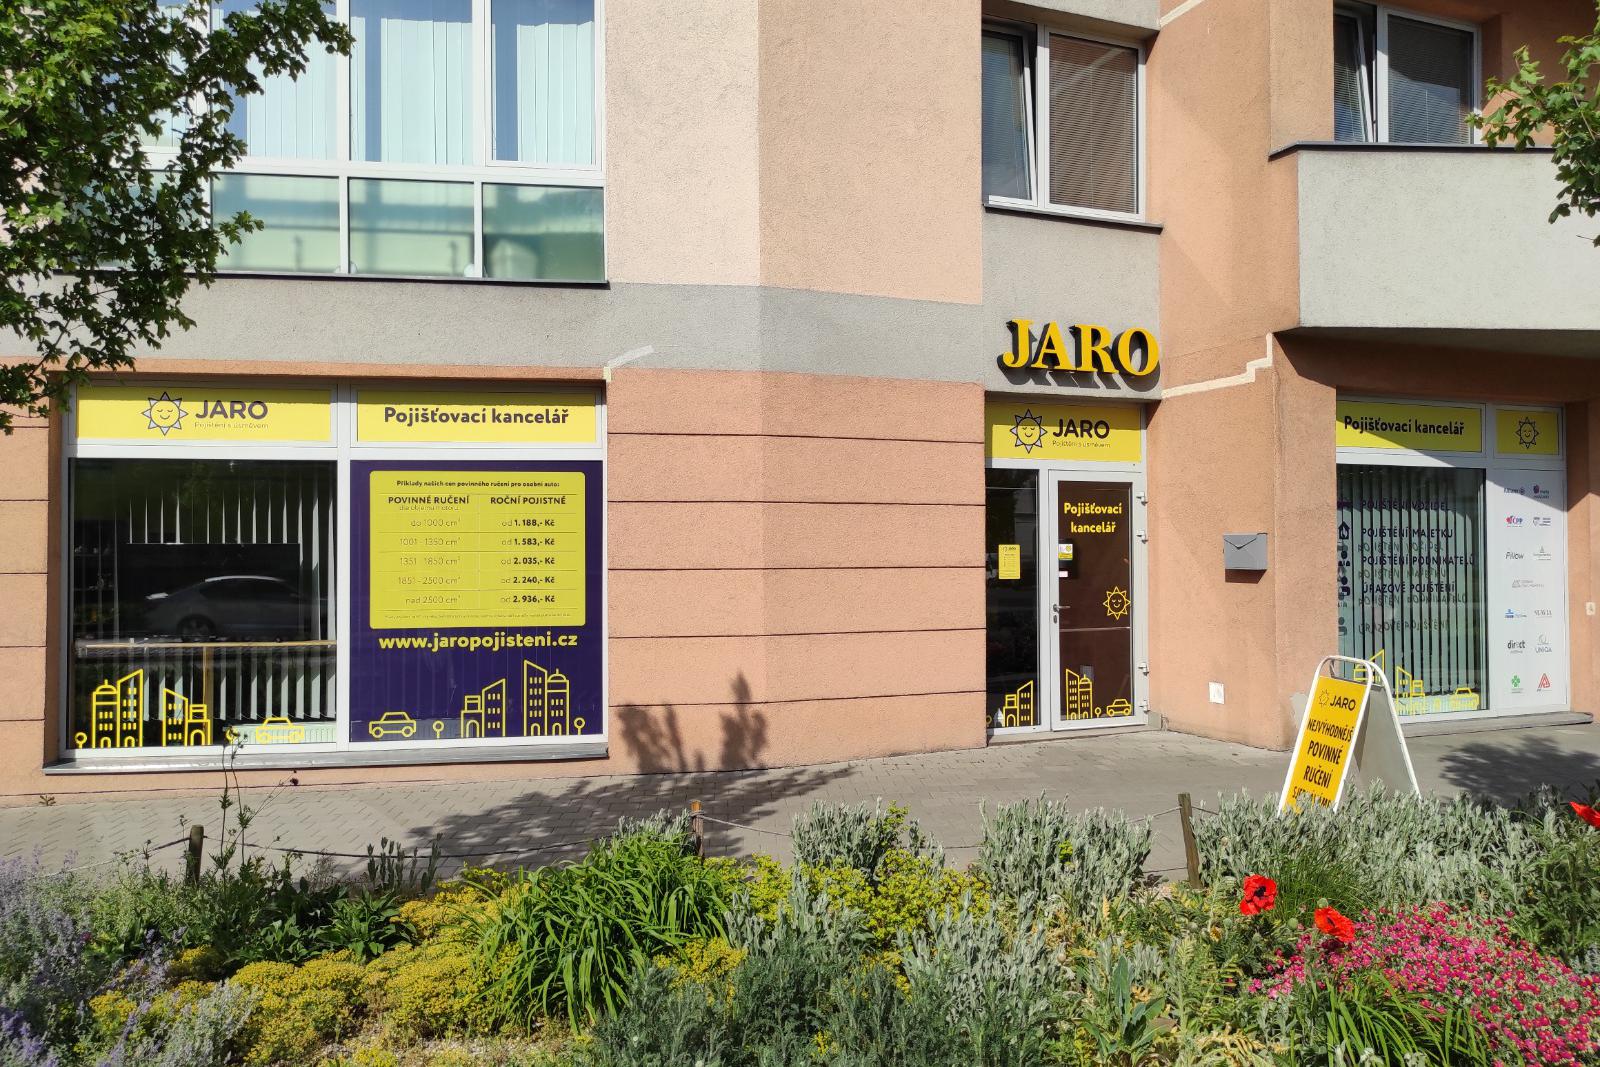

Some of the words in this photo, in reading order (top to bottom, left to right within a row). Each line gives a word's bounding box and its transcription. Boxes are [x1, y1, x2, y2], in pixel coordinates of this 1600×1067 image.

[1001, 318, 1160, 377] JARO
[195, 400, 268, 420] JARO
[384, 406, 486, 427] Pojišťovací
[491, 408, 569, 424] kancelář
[1052, 418, 1111, 440] JARO
[1344, 415, 1412, 434] Pojišťovací
[1415, 419, 1465, 436] kancelář
[457, 480, 490, 488] povinného
[388, 495, 432, 504] POVINNÉ
[434, 495, 470, 504] RUČENÍ
[490, 495, 520, 504] ROČNÍ
[523, 496, 567, 504] POJISTNÉ
[1064, 502, 1123, 517] Pojišťovací
[545, 519, 555, 527] Kč
[1070, 522, 1116, 533] kancelář
[1361, 526, 1409, 538] POJIŠTĚNÍ
[1412, 528, 1453, 538] MAJETKU
[545, 538, 555, 546] Kč
[545, 557, 555, 565] Kč
[1361, 554, 1409, 565] POJIŠTĚNÍ
[545, 576, 555, 584] Kč
[1409, 581, 1456, 593] POJIŠTĚNÍ
[545, 595, 555, 603] Kč
[378, 631, 578, 652] www.jaropojisteni.cz
[1330, 695, 1357, 711] JARO
[1307, 719, 1354, 742] NEJVÝHODNĚJŠ
[1307, 740, 1343, 765] POVINNÉ
[1303, 764, 1333, 789] RUČENÍ
